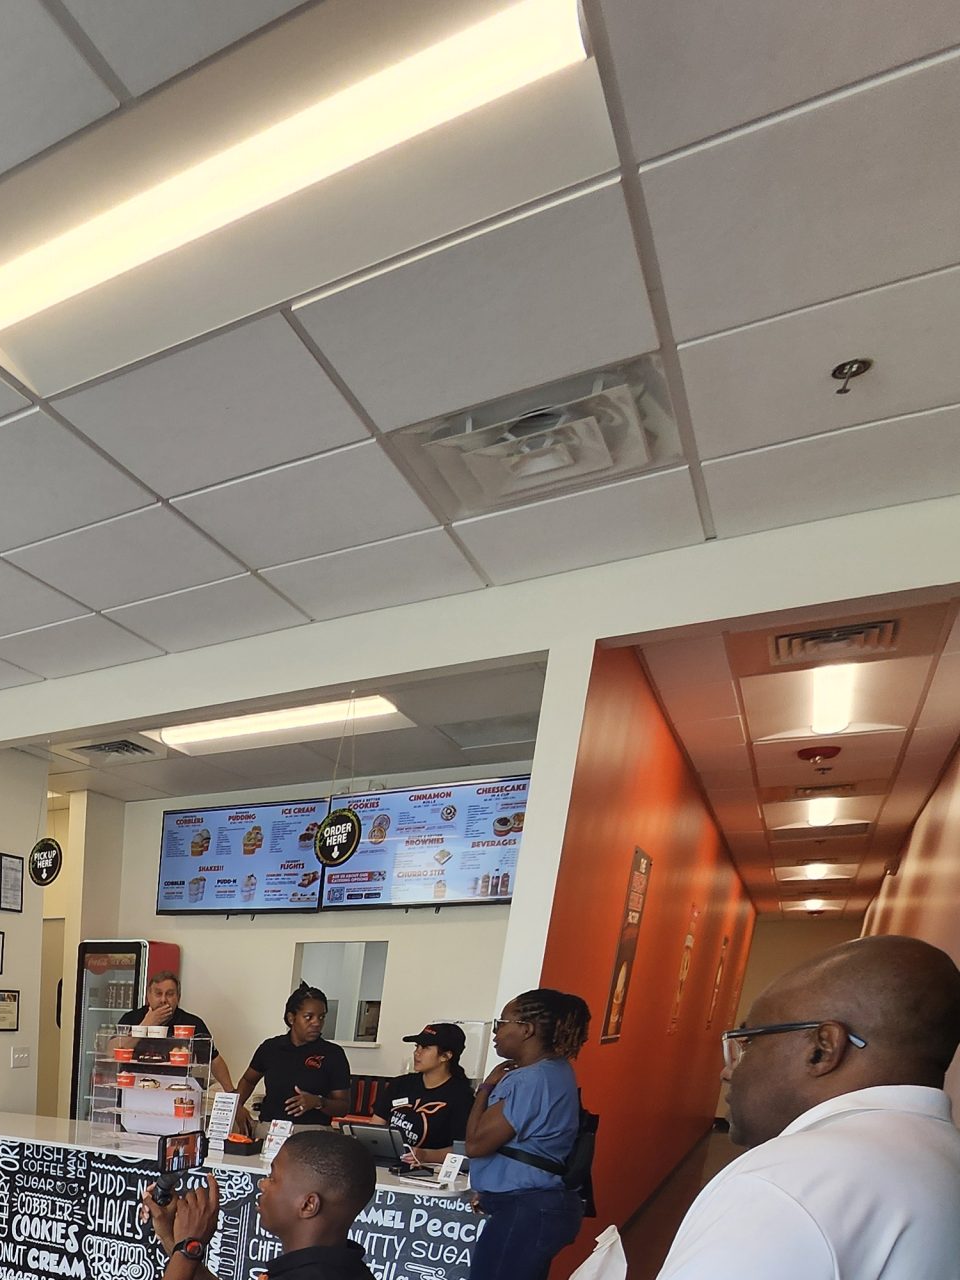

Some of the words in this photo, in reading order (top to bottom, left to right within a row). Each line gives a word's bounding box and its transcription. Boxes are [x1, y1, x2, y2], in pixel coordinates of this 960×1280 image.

[476, 783, 527, 795] CHEESECAKE
[408, 791, 452, 802] CINNAMON
[281, 808, 292, 816] ICE
[293, 807, 316, 815] CREAM
[348, 801, 380, 810] COOKIES
[176, 817, 204, 826] COBBLERS
[228, 813, 257, 822] PUDDING
[324, 822, 352, 838] ORDER
[326, 833, 348, 847] HERE
[404, 837, 445, 847] BROWNIES
[471, 838, 517, 848] BEVERAGES
[34, 851, 48, 861] PICK
[48, 849, 57, 859] UP
[37, 858, 53, 869] HERE
[391, 1116, 413, 1131] PEACH
[23, 1143, 64, 1162] RUSH
[22, 1159, 64, 1177] COFFEE
[14, 1174, 55, 1192] SUGAR
[17, 1194, 73, 1221] COBBLER
[87, 1195, 143, 1239] SHAKES
[11, 1214, 79, 1253] COOKIES
[27, 1248, 86, 1280] CREAM
